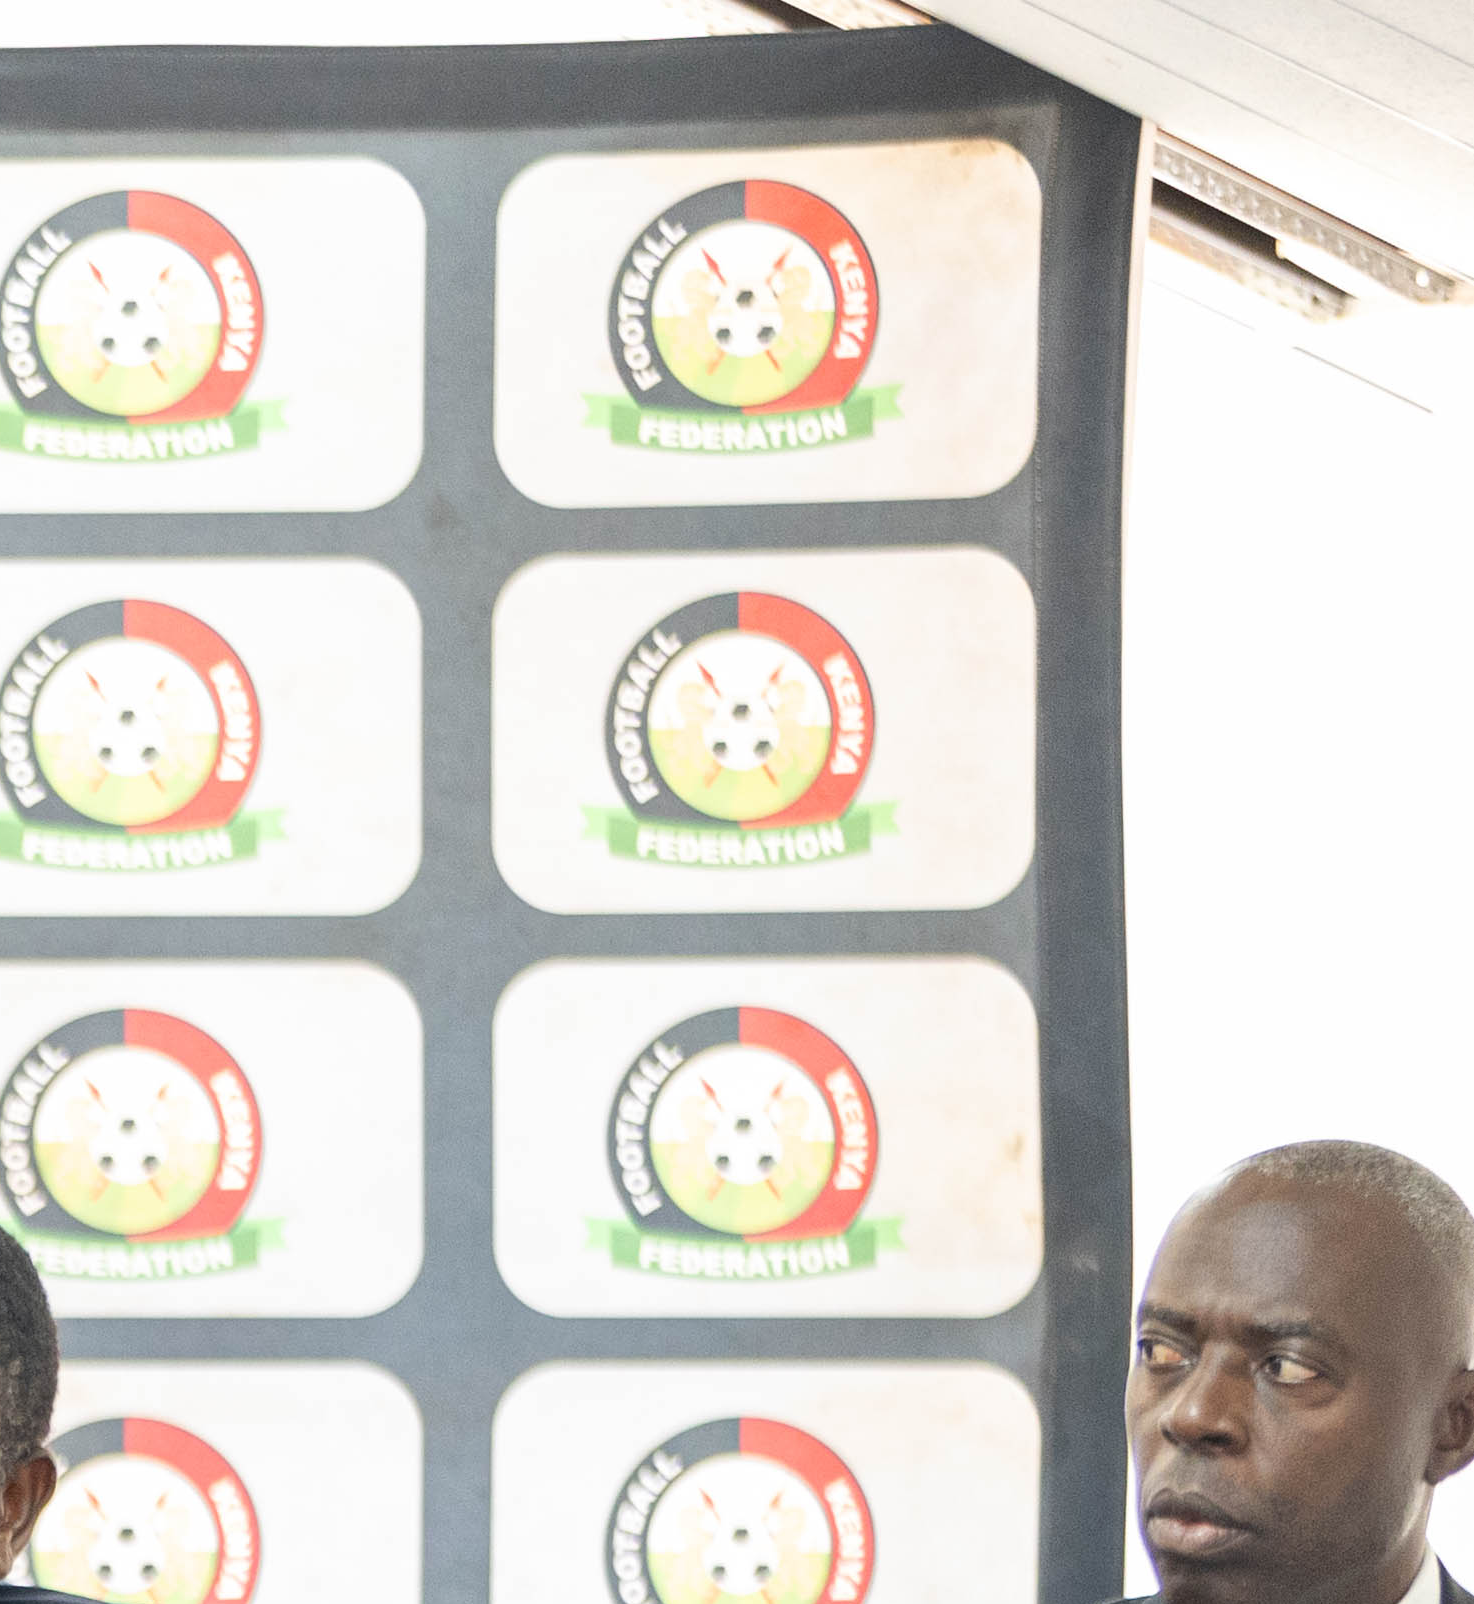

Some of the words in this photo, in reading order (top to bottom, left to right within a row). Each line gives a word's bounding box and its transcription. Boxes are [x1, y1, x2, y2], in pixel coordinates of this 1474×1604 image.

[1, 226, 72, 398] FOOTBALL
[617, 218, 688, 391] FOOTBALL
[829, 241, 870, 359] KENYA
[638, 413, 848, 450] FEDERATION
[0, 635, 70, 807] FOOTBALL
[613, 629, 684, 804] FOOTBALL
[825, 655, 865, 774] KENYA
[636, 827, 846, 865] FEDERATION
[615, 1042, 686, 1216] FOOTBALL
[640, 1240, 851, 1278] FEDERATION
